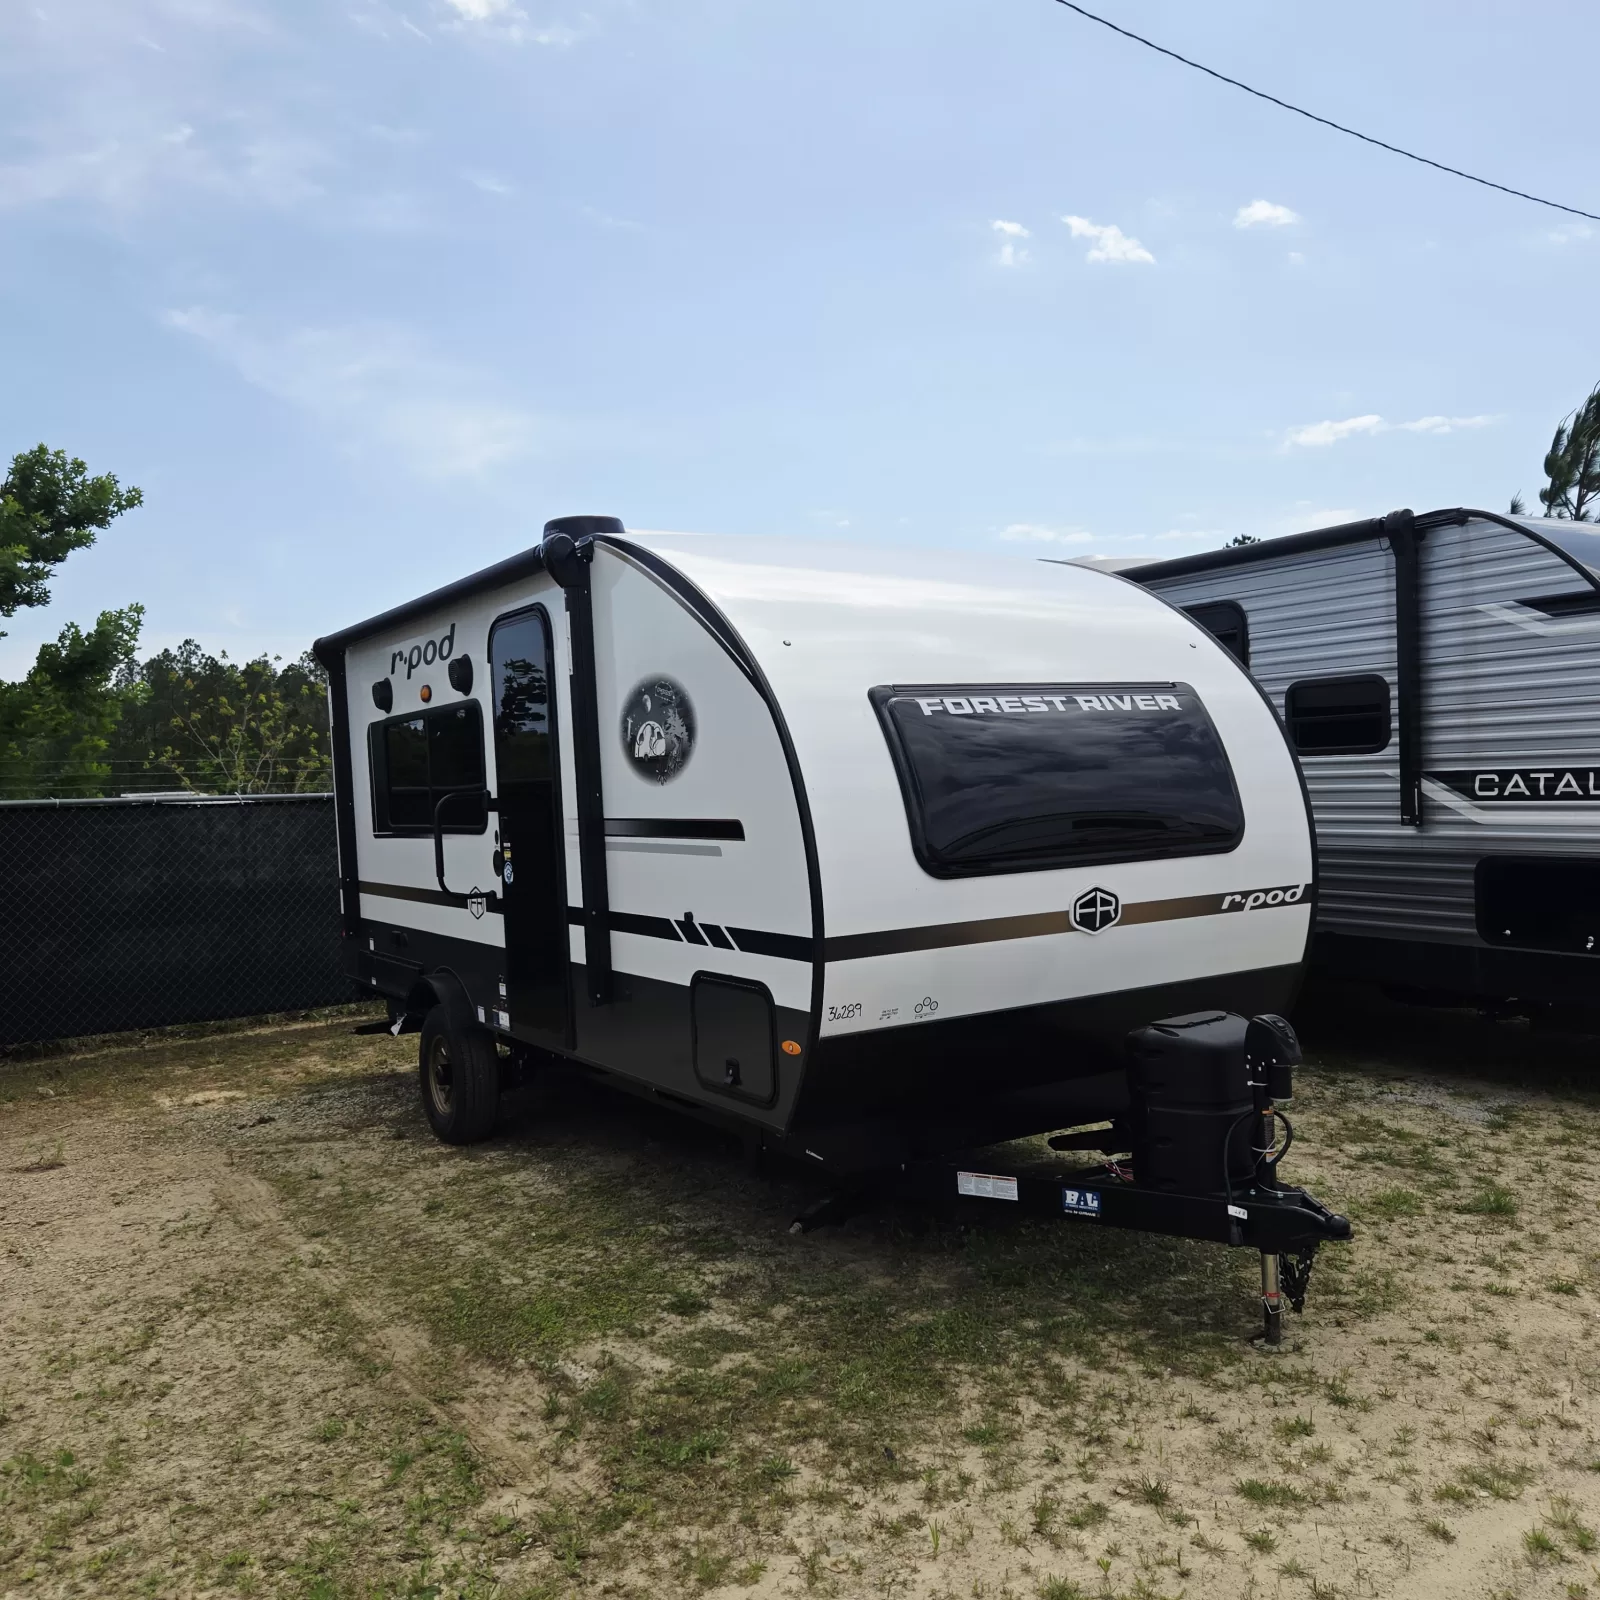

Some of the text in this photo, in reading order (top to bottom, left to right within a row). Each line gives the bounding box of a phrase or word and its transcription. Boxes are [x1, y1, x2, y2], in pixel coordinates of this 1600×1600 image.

[914, 695, 1183, 716] FOREST RIVER
[1474, 771, 1600, 796] CATAL
[827, 1002, 862, 1022] 36289
